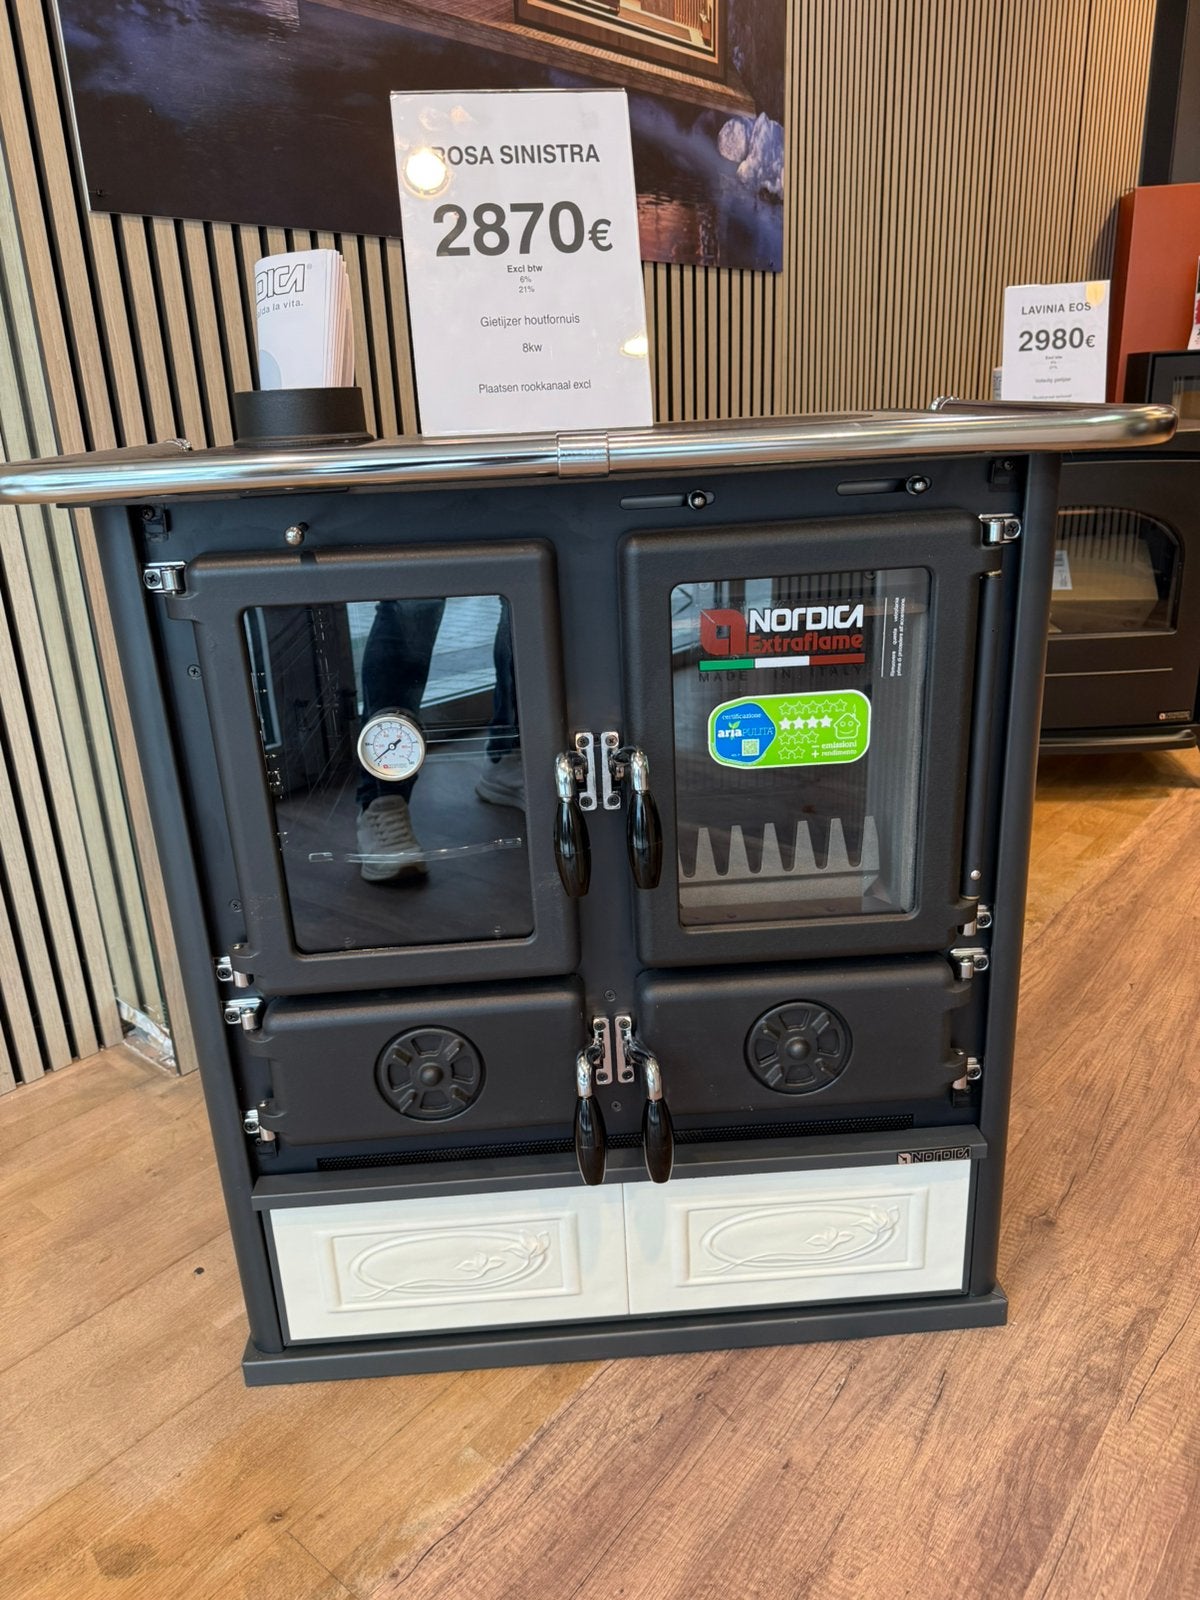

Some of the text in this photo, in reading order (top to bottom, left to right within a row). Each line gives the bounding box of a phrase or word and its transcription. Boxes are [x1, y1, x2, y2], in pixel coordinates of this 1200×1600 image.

[499, 143, 601, 165] SINISTRA
[433, 200, 614, 257] 2870€
[506, 263, 544, 274] Excl btw
[518, 285, 536, 294] 21%
[1021, 301, 1092, 315] LAVINIA EOS
[480, 312, 581, 329] Gietijzer houtfornuis
[522, 342, 543, 353] 8kw
[1018, 326, 1096, 353] 2980€
[478, 379, 592, 394] Plaatsen rookkanaal excl
[747, 633, 864, 653] Extraflame
[698, 665, 862, 683] MADE IN ITALY
[722, 712, 762, 720] certificazione
